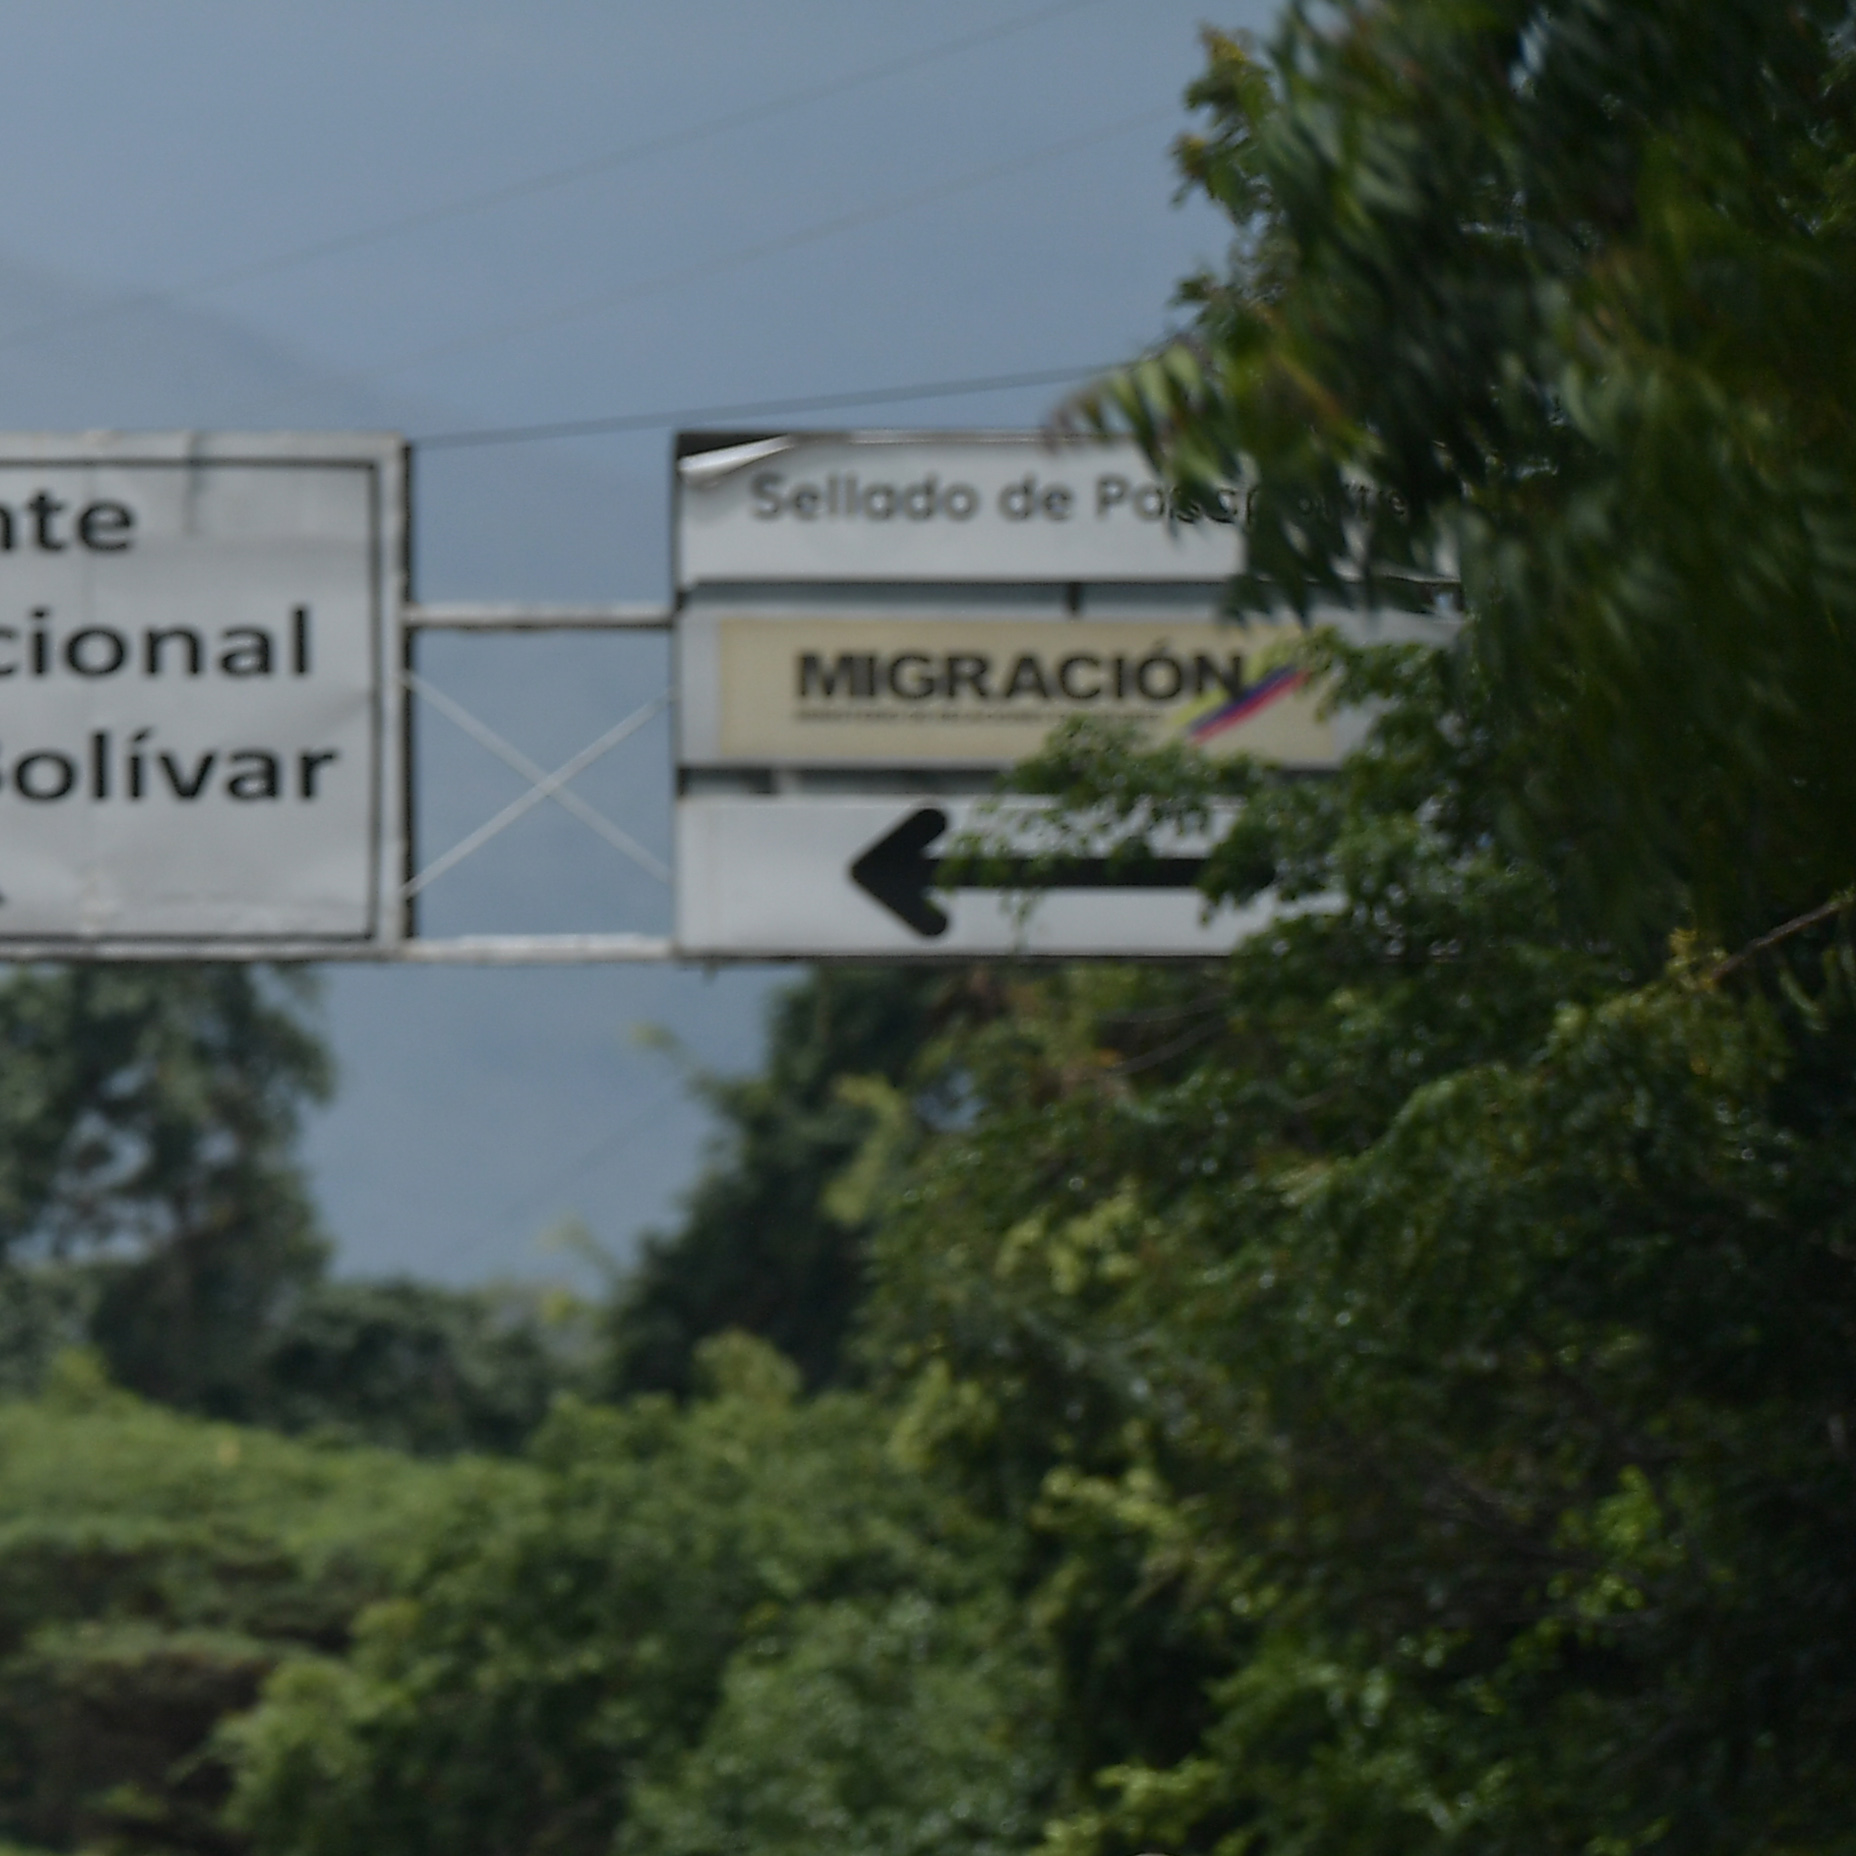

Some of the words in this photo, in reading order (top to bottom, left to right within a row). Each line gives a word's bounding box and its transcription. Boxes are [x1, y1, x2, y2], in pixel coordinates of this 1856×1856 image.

[750, 470, 980, 523] Sellado
[999, 470, 1073, 523] de
[798, 638, 1245, 700] MIGRACIÓN
